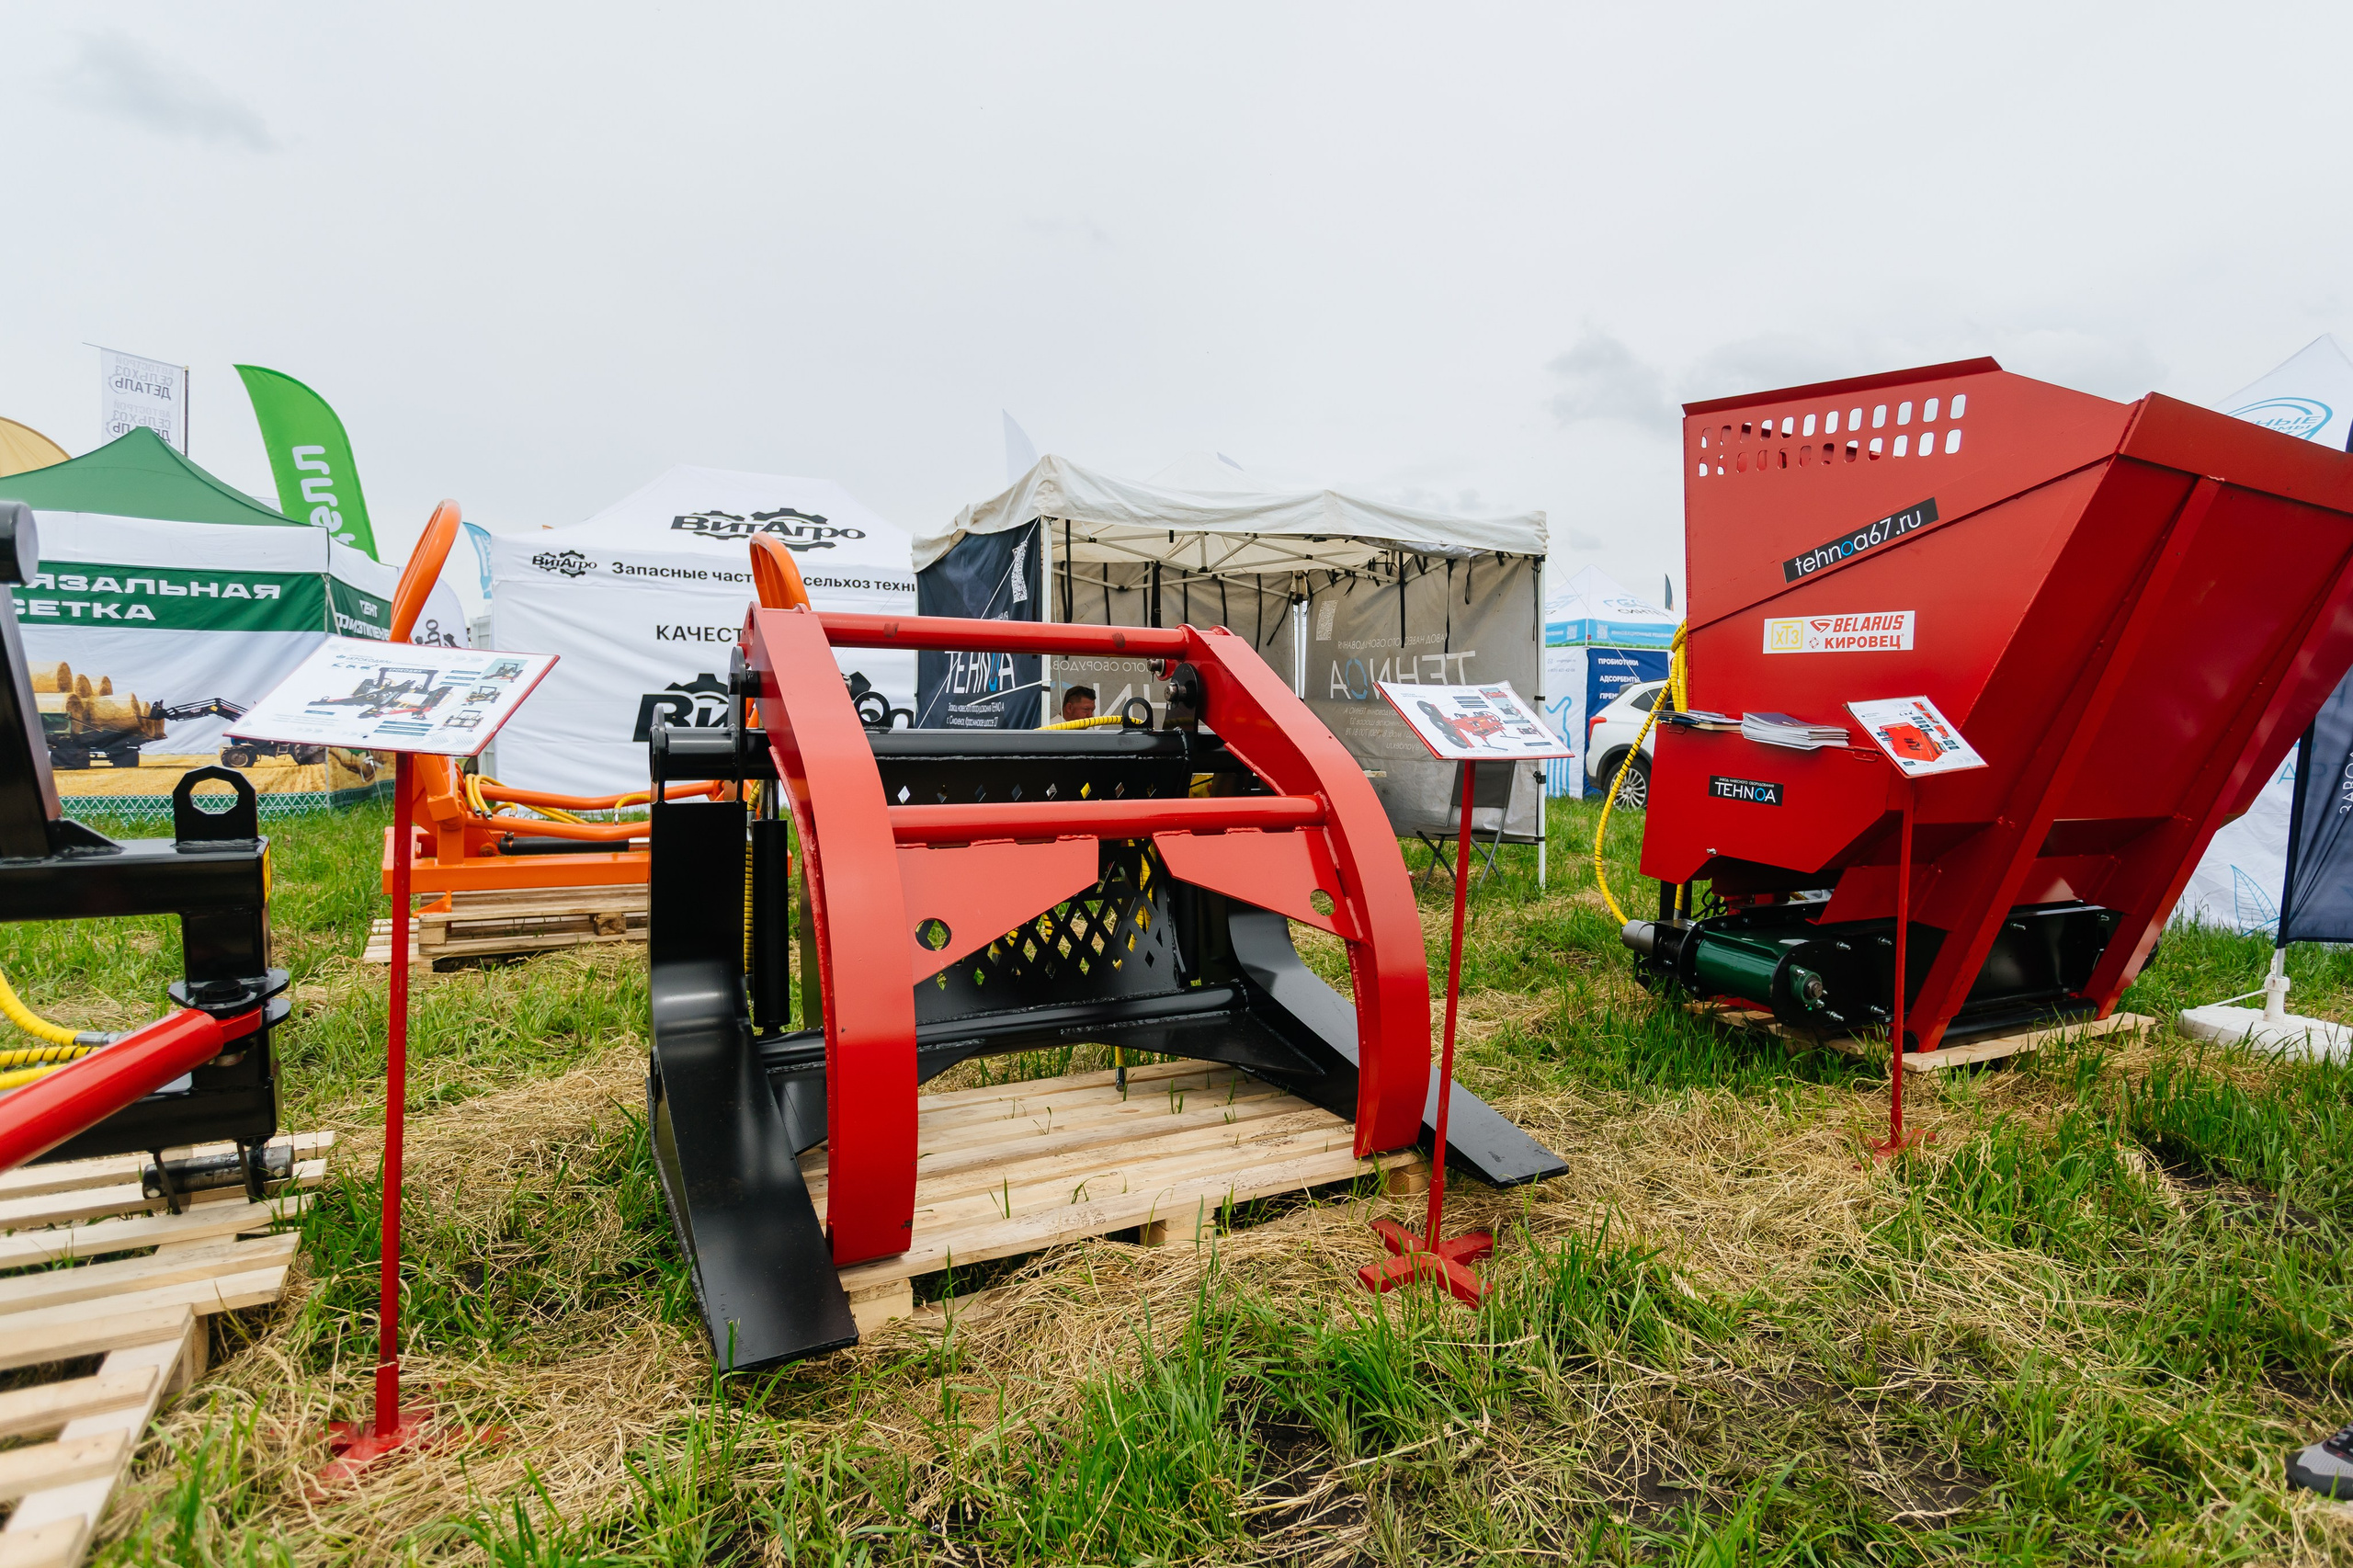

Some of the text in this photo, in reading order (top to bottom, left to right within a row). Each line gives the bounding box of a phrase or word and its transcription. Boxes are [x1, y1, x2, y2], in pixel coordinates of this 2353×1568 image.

[670, 515, 867, 541] ВитАгро
[1795, 509, 1922, 576] tehnoa67.ru
[532, 554, 597, 571] ВитАгро
[9, 573, 281, 599] ЯЗАЛЬНАЯ
[611, 561, 708, 581] Запасные
[711, 570, 754, 584] част
[802, 574, 870, 590] сельхоз
[655, 624, 742, 642] КАЧЕСТ
[1833, 614, 1904, 633] BELARUS
[1824, 634, 1901, 650] КИРОВЕЦ
[1714, 781, 1776, 802] TEHNOA
